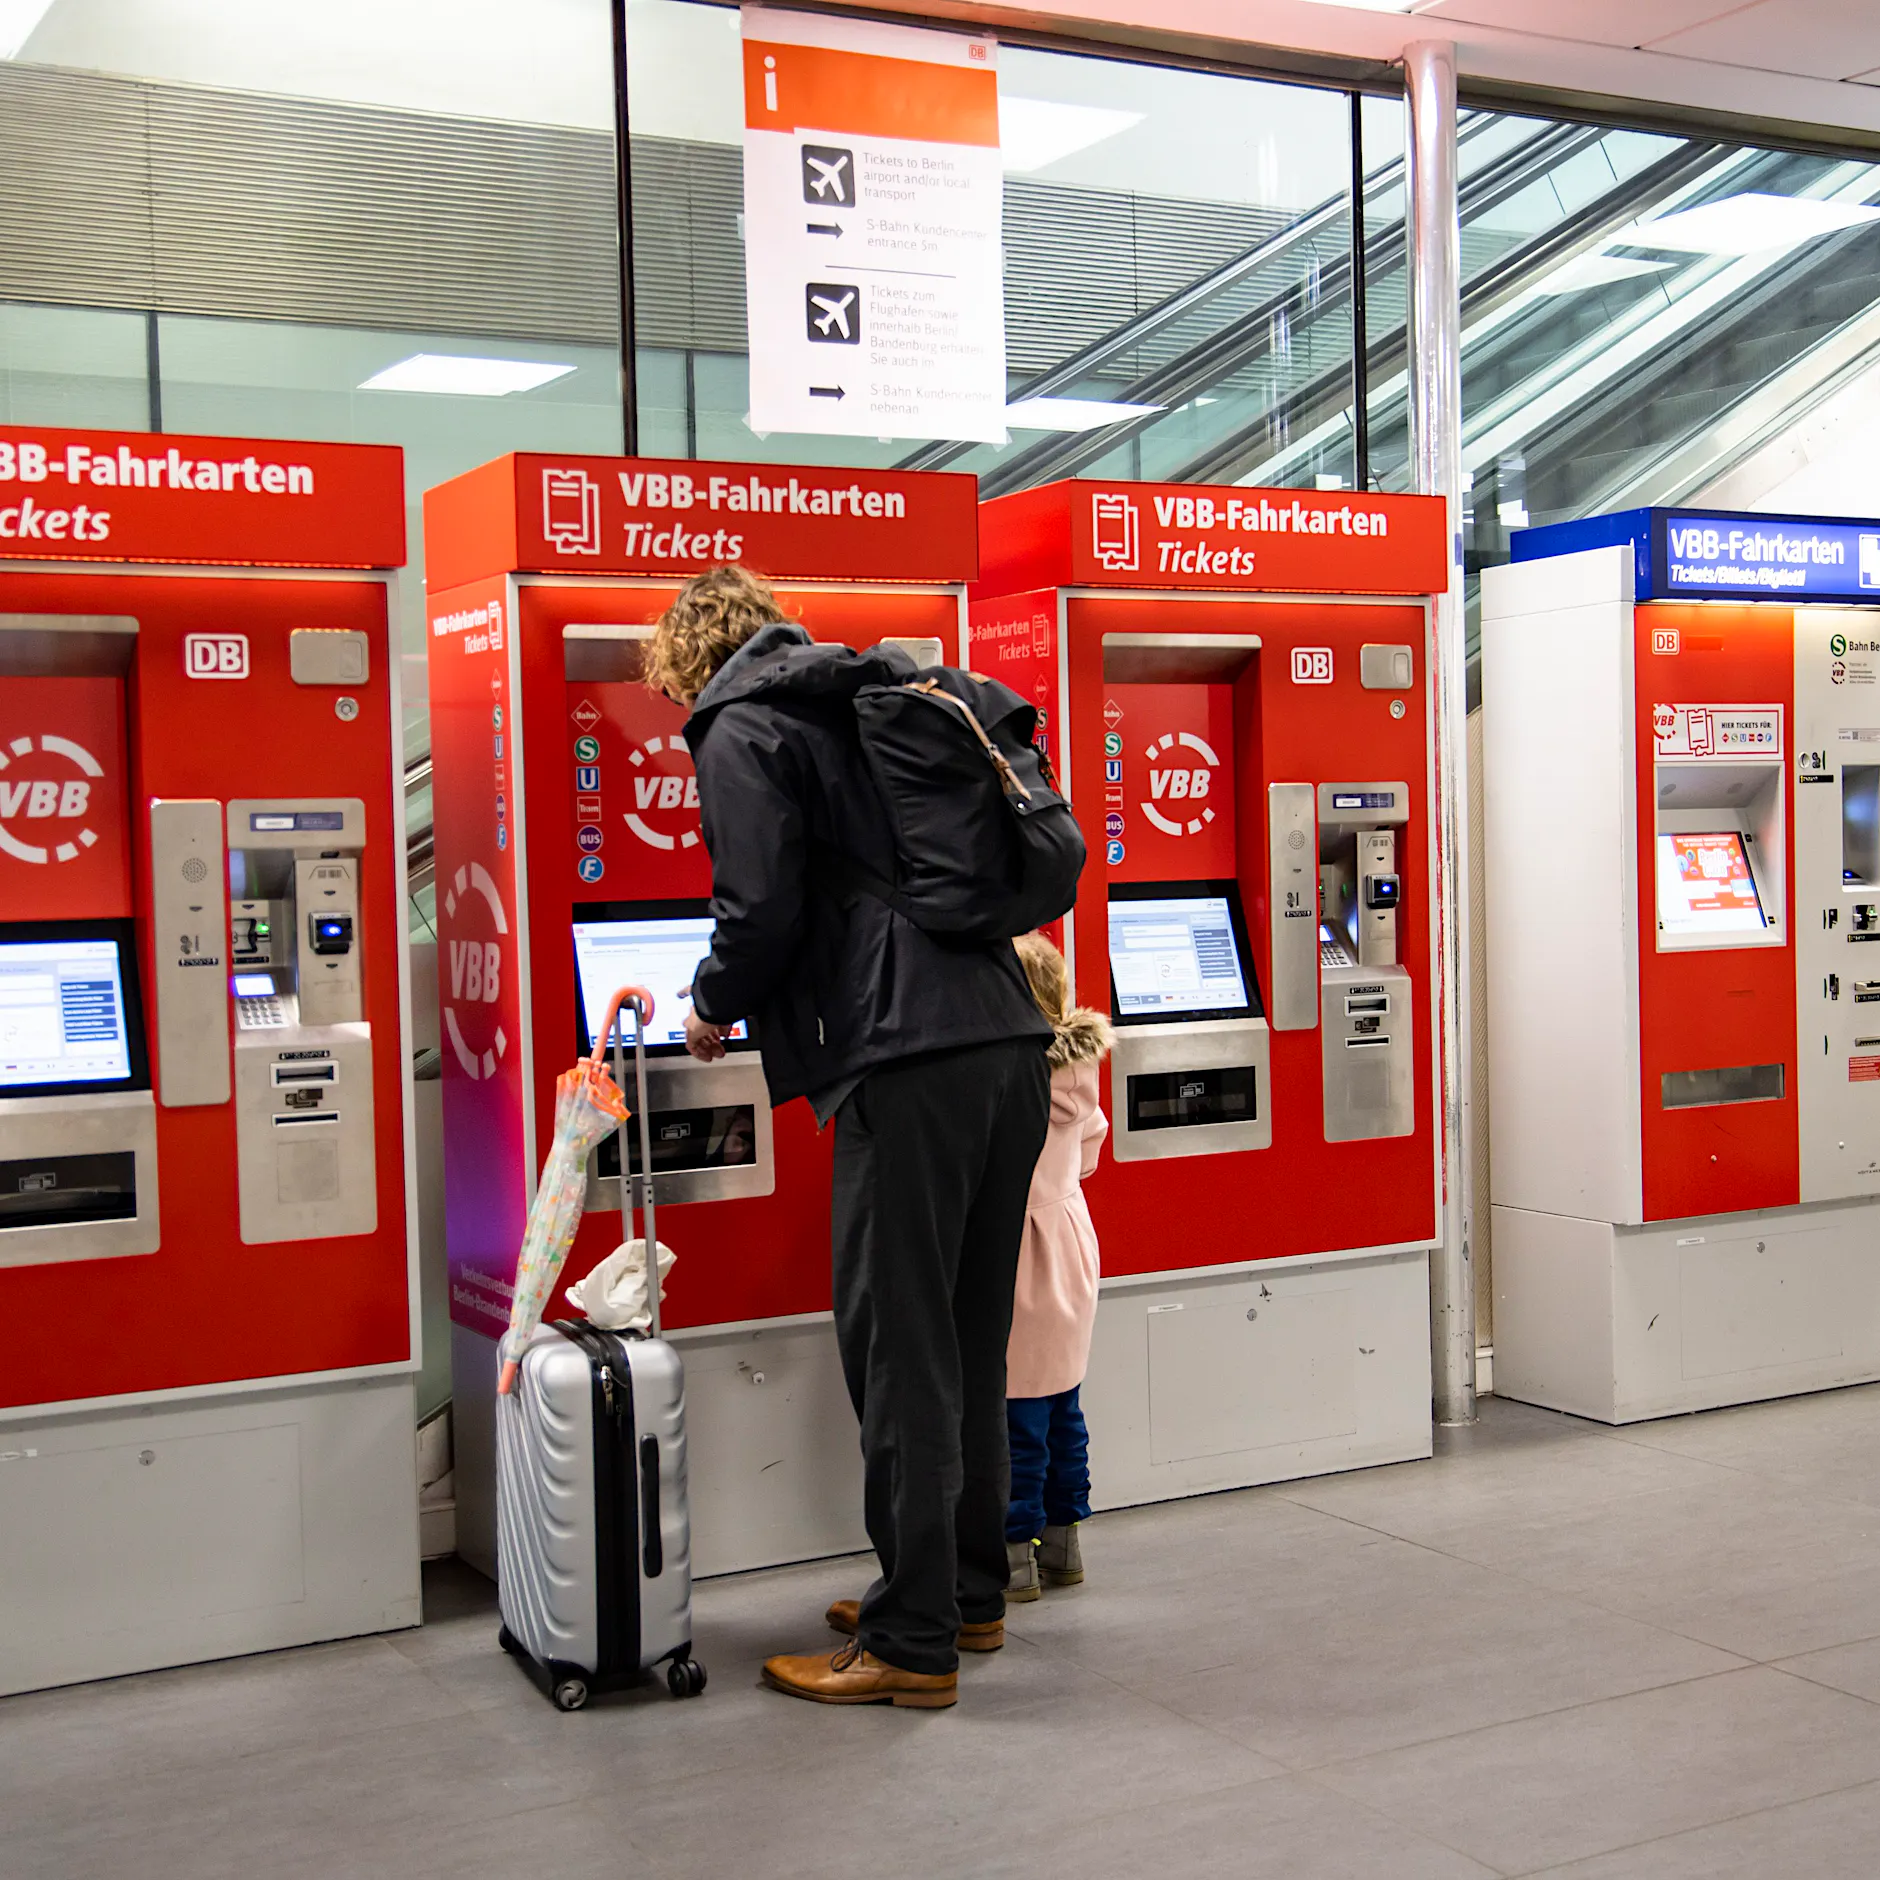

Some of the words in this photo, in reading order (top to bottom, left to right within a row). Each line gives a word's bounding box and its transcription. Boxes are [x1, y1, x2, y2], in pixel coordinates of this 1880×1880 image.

[970, 46, 985, 59] DB
[863, 152, 904, 168] Tickets
[907, 158, 918, 168] to
[922, 158, 954, 171] Berlin
[864, 171, 900, 184] airport
[904, 174, 940, 188] and/or
[943, 175, 970, 189] local
[864, 187, 916, 202] transport
[866, 218, 910, 234] S-Bahn
[913, 222, 988, 240] Kundencenter
[867, 237, 918, 250] entrance
[920, 240, 938, 252] 5m
[870, 284, 910, 300] Tickets
[912, 292, 936, 302] zum
[870, 302, 925, 318] Flughafen
[928, 309, 959, 321] sowie
[869, 320, 922, 334] innerhalb
[870, 336, 938, 355] Bandenburg
[870, 352, 888, 366] Sie
[892, 356, 918, 367] auch
[921, 358, 935, 368] im
[870, 383, 912, 398] S-Bahn
[916, 387, 992, 402] Kundencenter
[870, 402, 920, 415] nebenan
[618, 472, 906, 518] VBB-Fahrkarten
[1154, 496, 1388, 537] VBB-Fahrkarten
[622, 523, 744, 561] Tickets
[1670, 528, 1844, 564] VBB-Fahrkarten
[1157, 542, 1255, 576] Tickets
[432, 608, 488, 636] VBB-Fahrkarten
[464, 634, 488, 655] Tickets
[998, 642, 1030, 660] Tickets
[1656, 634, 1676, 650] DB
[1832, 634, 1846, 656] S
[1849, 641, 1868, 651] Bahn
[193, 640, 243, 673] DB
[1296, 652, 1329, 678] DB
[576, 711, 597, 720] Bahn
[1104, 710, 1120, 718] Bahn
[1654, 715, 1674, 726] VBB
[579, 739, 596, 760] S
[1105, 734, 1119, 754] S
[580, 769, 596, 790] U
[1106, 762, 1119, 780] U
[1150, 769, 1211, 800] VBB
[0, 780, 90, 818] VBB
[1106, 793, 1122, 802] Tram
[580, 804, 599, 813] Tram
[1106, 820, 1122, 830] BUS
[580, 834, 600, 845] BUS
[450, 940, 500, 1002] VBB
